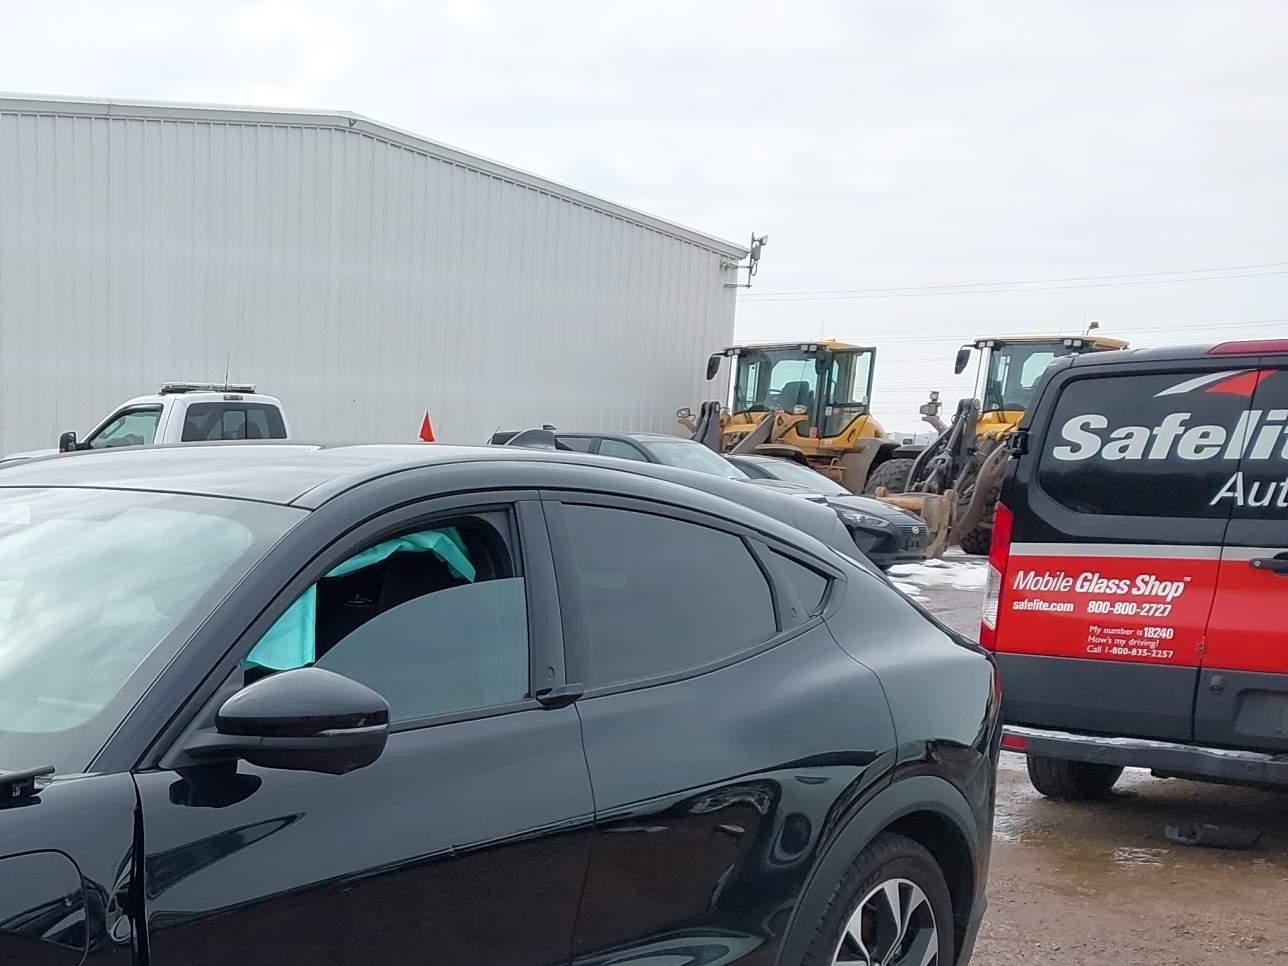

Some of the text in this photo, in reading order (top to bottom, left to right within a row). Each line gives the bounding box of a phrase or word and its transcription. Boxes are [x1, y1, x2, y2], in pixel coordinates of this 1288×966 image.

[1012, 570, 1073, 592] Mobile
[1074, 572, 1129, 595] Glass
[1012, 598, 1172, 617] safelite.com 800-800-2727
[1089, 625, 1174, 640] My number is 18240
[1088, 636, 1112, 645] How's
[1114, 638, 1127, 647] my
[1086, 645, 1174, 659] Call 1-800-835-2257
